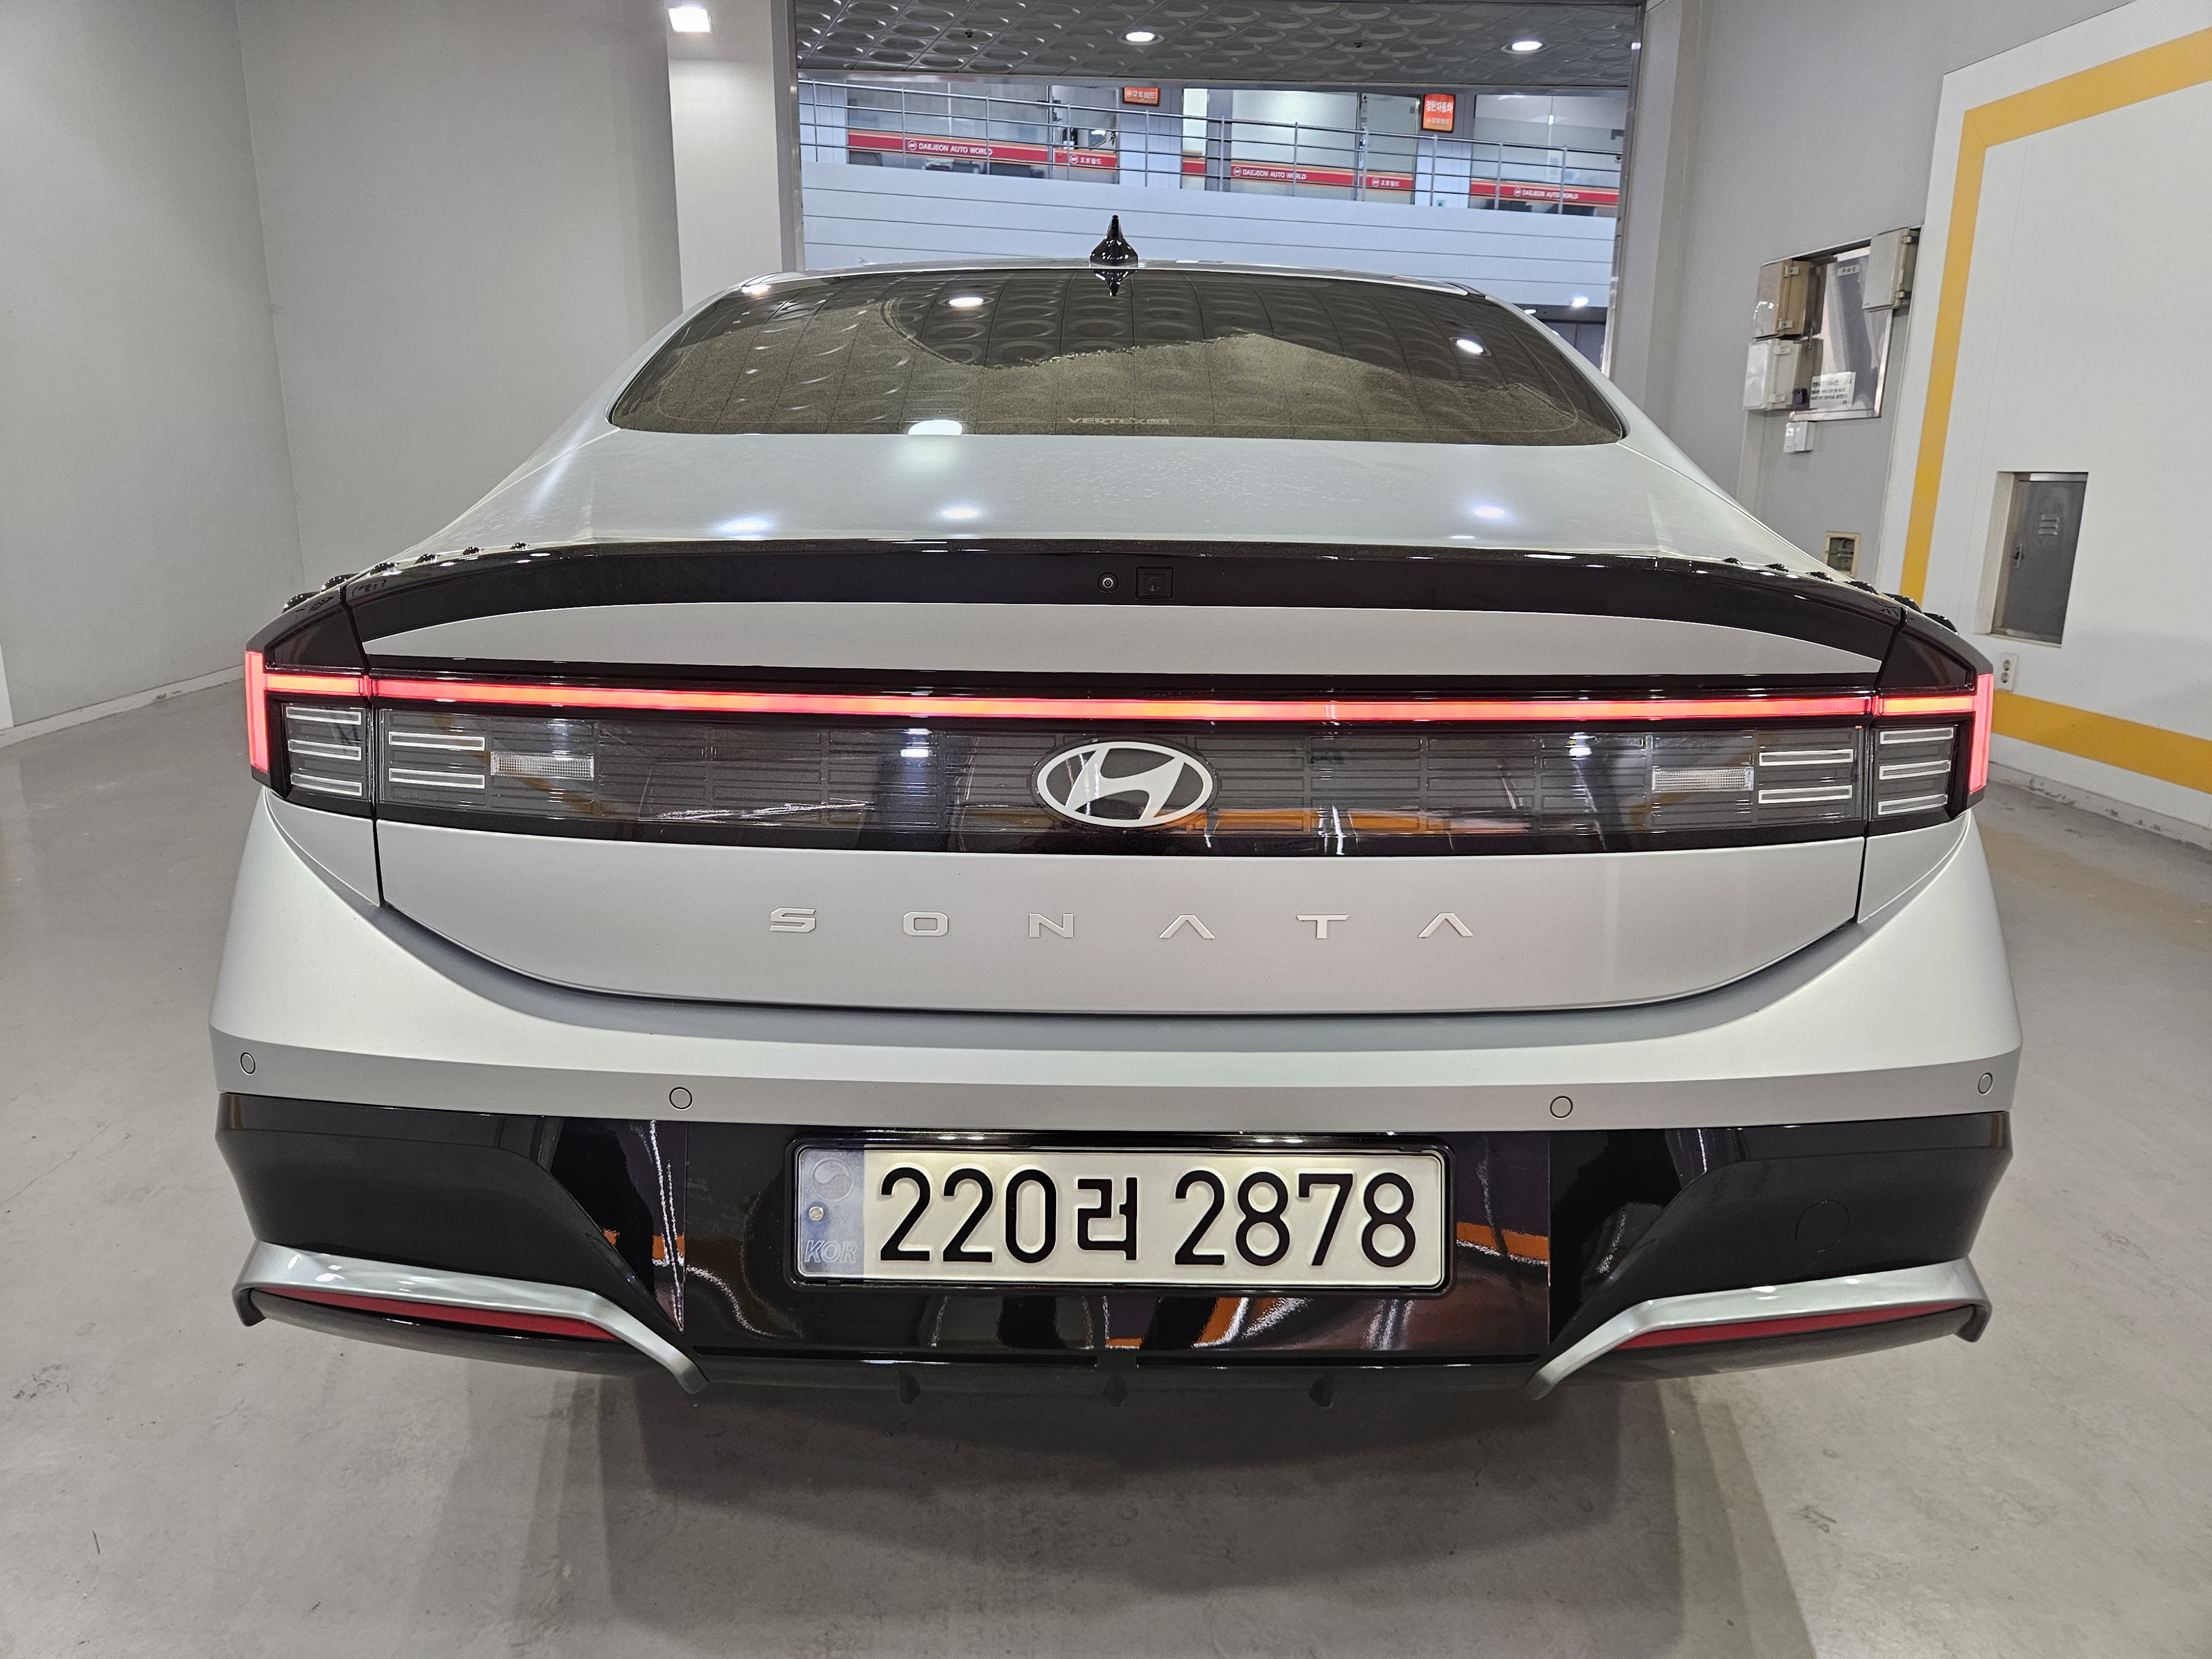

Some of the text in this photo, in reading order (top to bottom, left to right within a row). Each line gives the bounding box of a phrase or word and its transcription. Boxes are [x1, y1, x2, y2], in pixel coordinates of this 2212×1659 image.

[919, 143, 948, 152] DAEJEON
[951, 145, 968, 153] AUTO
[1067, 417, 1146, 425] VERTEX
[769, 907, 1473, 938] SONATA
[881, 1167, 1416, 1267] 220러 2878
[804, 1240, 857, 1263] KOR
